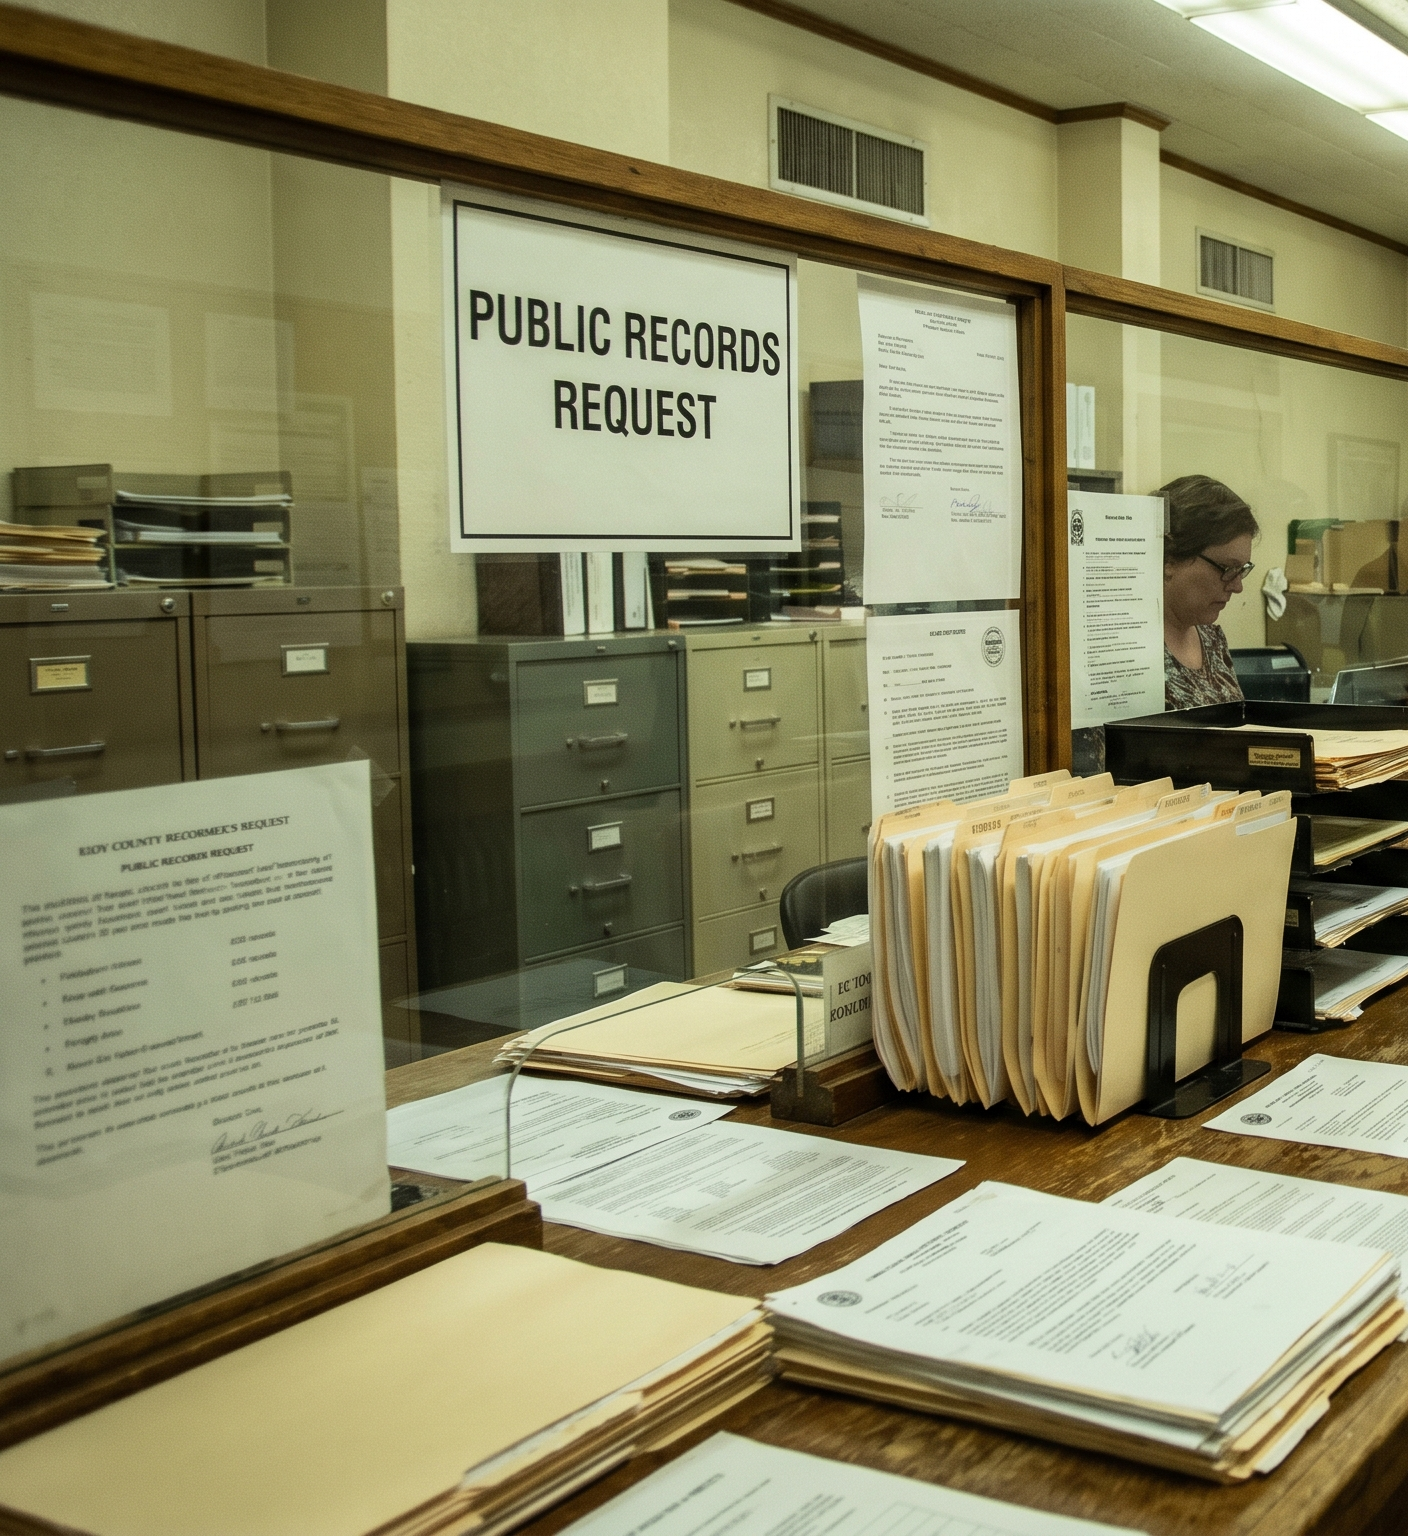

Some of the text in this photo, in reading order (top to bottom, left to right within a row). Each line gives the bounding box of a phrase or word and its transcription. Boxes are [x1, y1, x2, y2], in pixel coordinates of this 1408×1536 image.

[469, 289, 781, 376] PUBLIC RECORDS
[554, 379, 717, 439] REQUEST
[111, 835, 162, 851] COUNTY
[121, 859, 159, 873] PUBLIC
